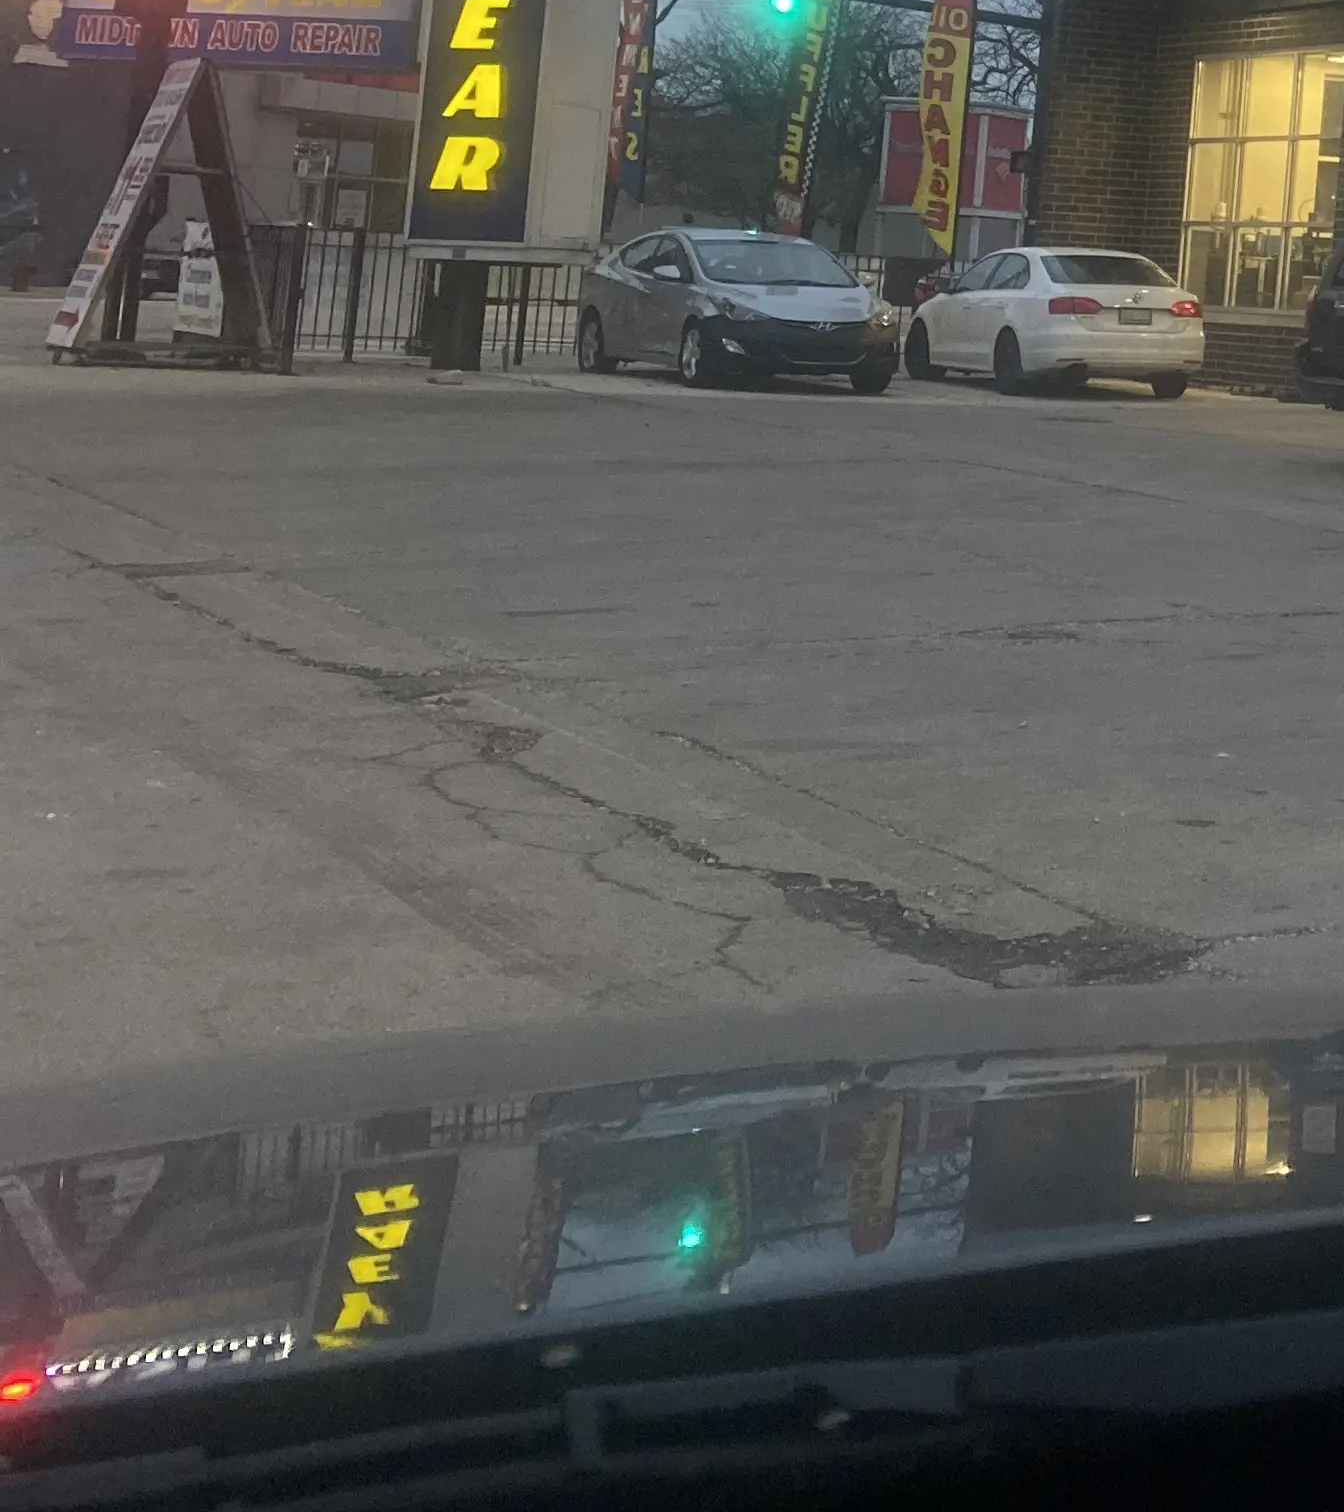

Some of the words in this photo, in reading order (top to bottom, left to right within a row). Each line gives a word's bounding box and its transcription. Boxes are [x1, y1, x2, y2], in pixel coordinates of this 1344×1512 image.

[74, 14, 200, 49] MIDTWN
[207, 19, 280, 52] AUTO
[290, 21, 383, 57] REPAIR
